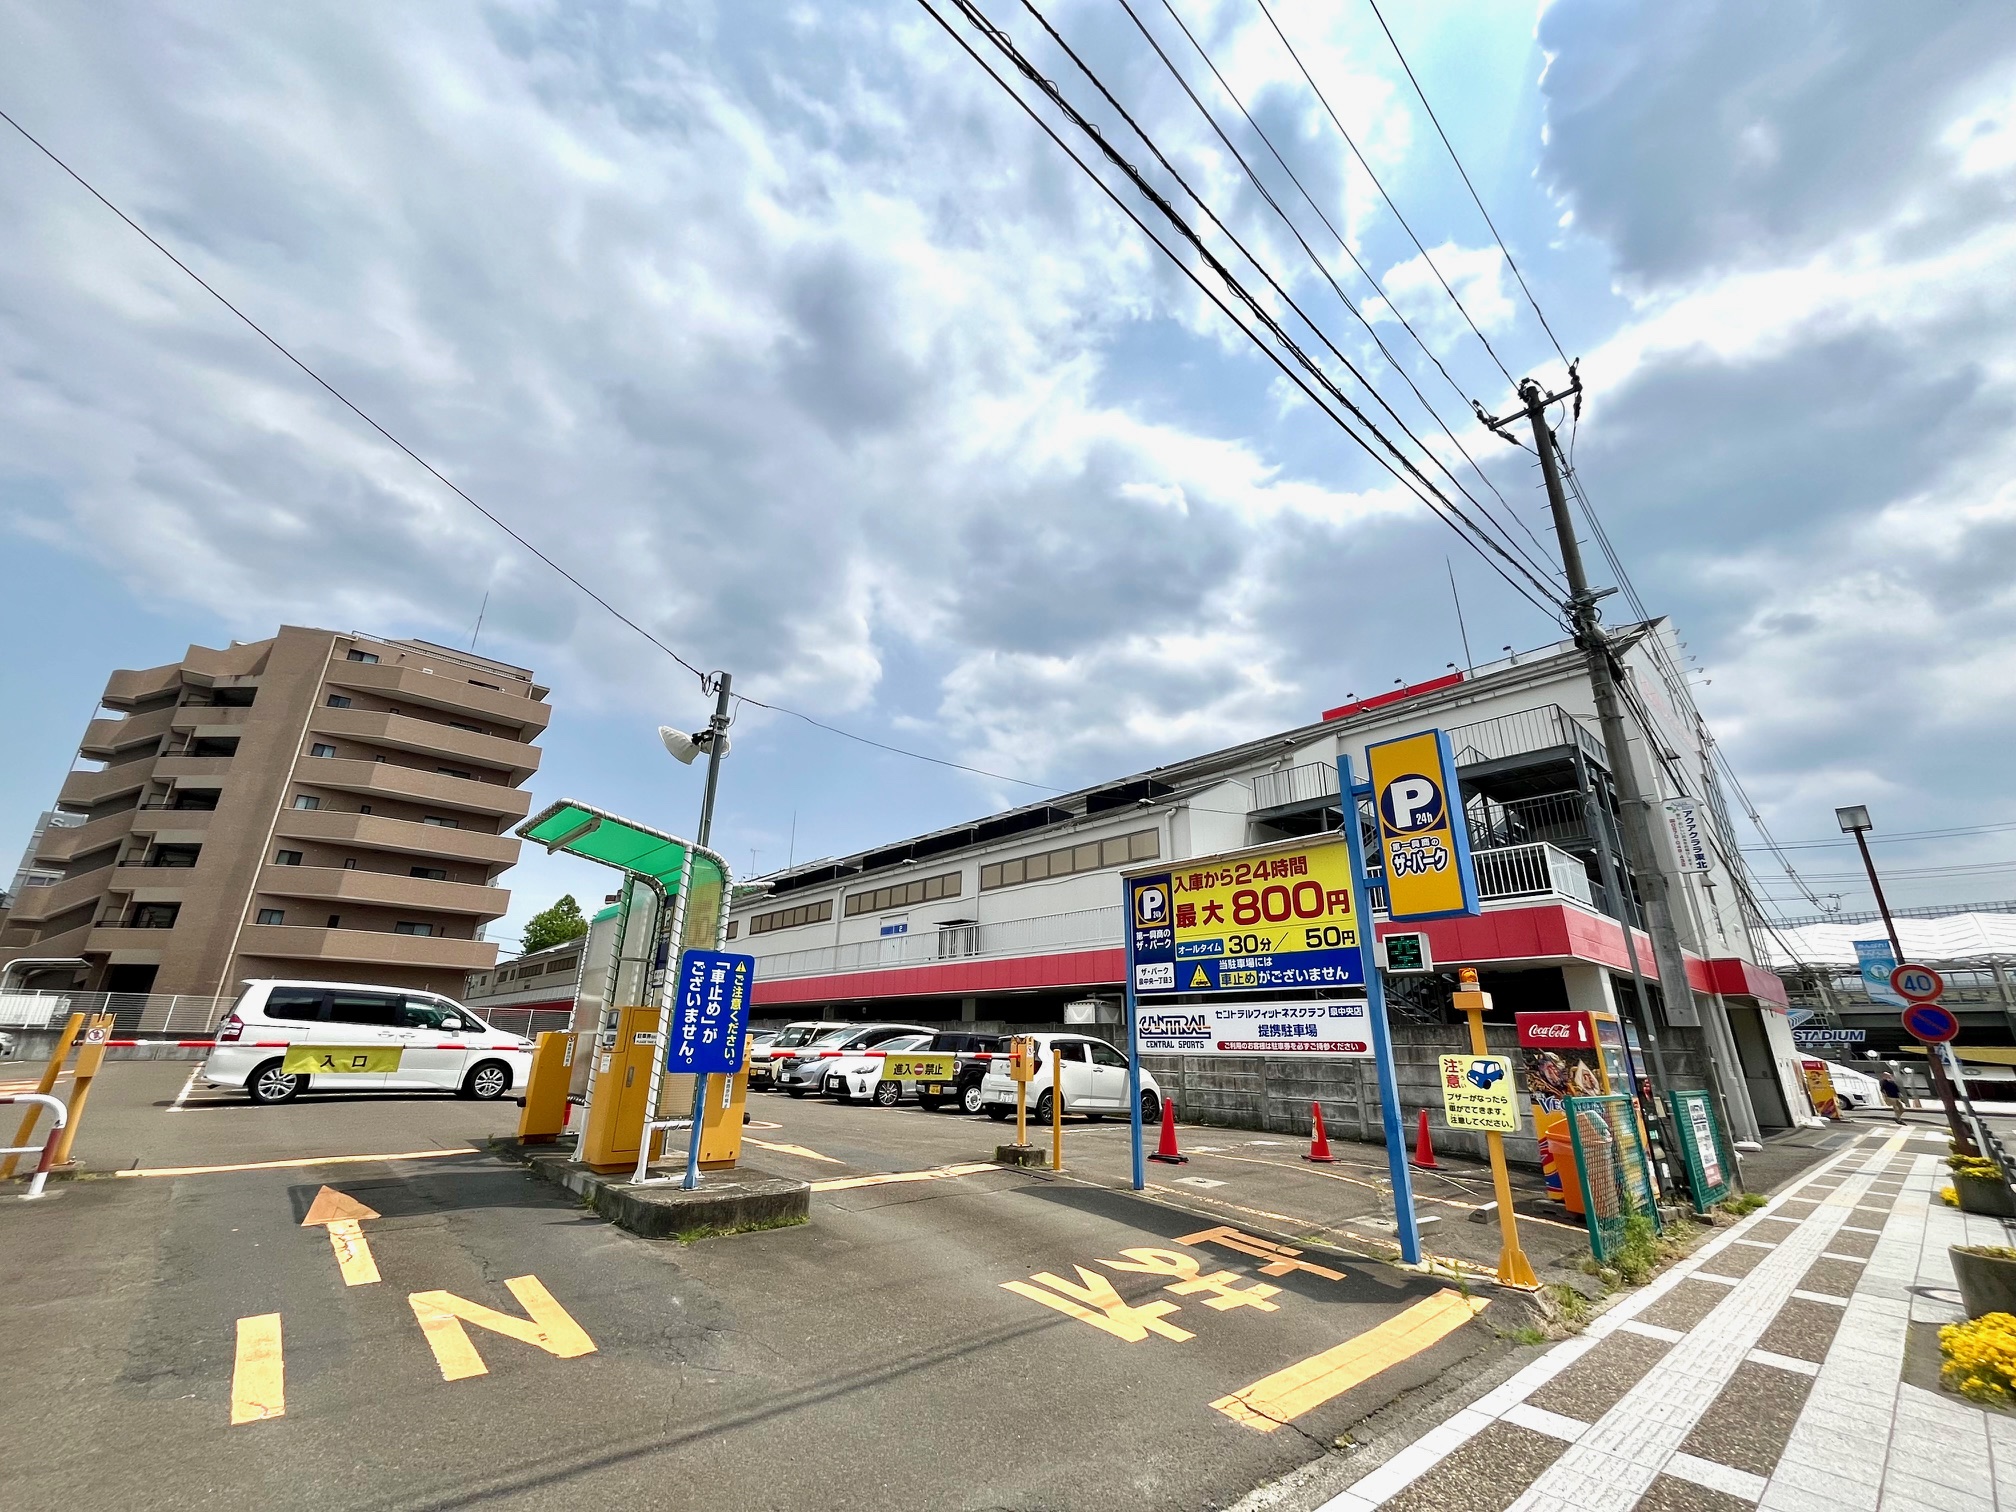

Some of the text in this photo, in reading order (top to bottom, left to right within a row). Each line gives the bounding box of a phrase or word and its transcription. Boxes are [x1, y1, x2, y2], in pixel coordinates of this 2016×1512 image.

[1390, 778, 1434, 829] P
[1415, 812, 1433, 825] 24h
[1392, 847, 1448, 877] ザ・パーク
[1174, 855, 1308, 894] 入庫から24時間
[1143, 889, 1163, 920] P
[1136, 939, 1172, 951] ザ・パーク
[1306, 926, 1356, 949] 50円
[1178, 943, 1222, 955] オールタイム
[1219, 956, 1273, 970] 当駐車場には
[1141, 966, 1169, 976] ザ・パーク
[1904, 975, 1932, 992] 40
[700, 961, 731, 1044] 「車止め」が
[678, 961, 706, 1065] ございません。
[724, 974, 745, 1066] ご注意ください。
[1215, 1006, 1363, 1019] セントラルフィットネスクラブ 泉中央店
[1138, 1014, 1212, 1039] CENTRAL
[1258, 1024, 1318, 1038] 提携駐車場
[1528, 1024, 1571, 1038] Coca-Cola
[1793, 1030, 1864, 1041] STADIUM
[1146, 1040, 1205, 1049] CENTRAL SPORTS
[320, 1054, 368, 1068] 入口
[1443, 1058, 1461, 1089] 注意
[1447, 1093, 1508, 1104] ブザーがなったら
[230, 1273, 598, 1425] IN
